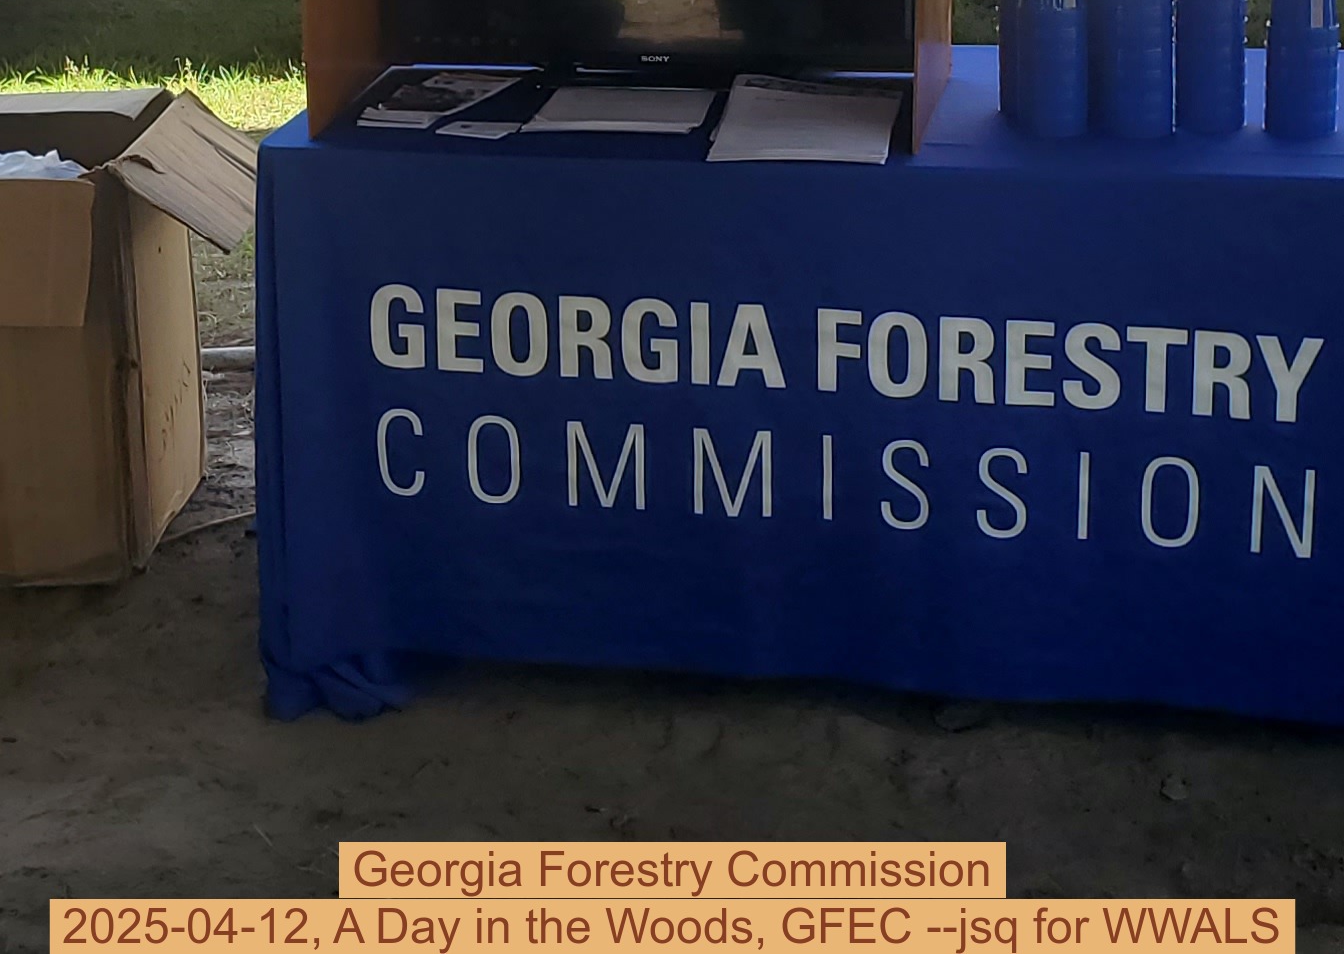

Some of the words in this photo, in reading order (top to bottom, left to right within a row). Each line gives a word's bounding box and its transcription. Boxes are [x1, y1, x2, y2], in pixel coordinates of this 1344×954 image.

[371, 285, 785, 387] GEORGIA
[818, 309, 1323, 422] FORESTRY
[377, 409, 1316, 557] COMMISSION
